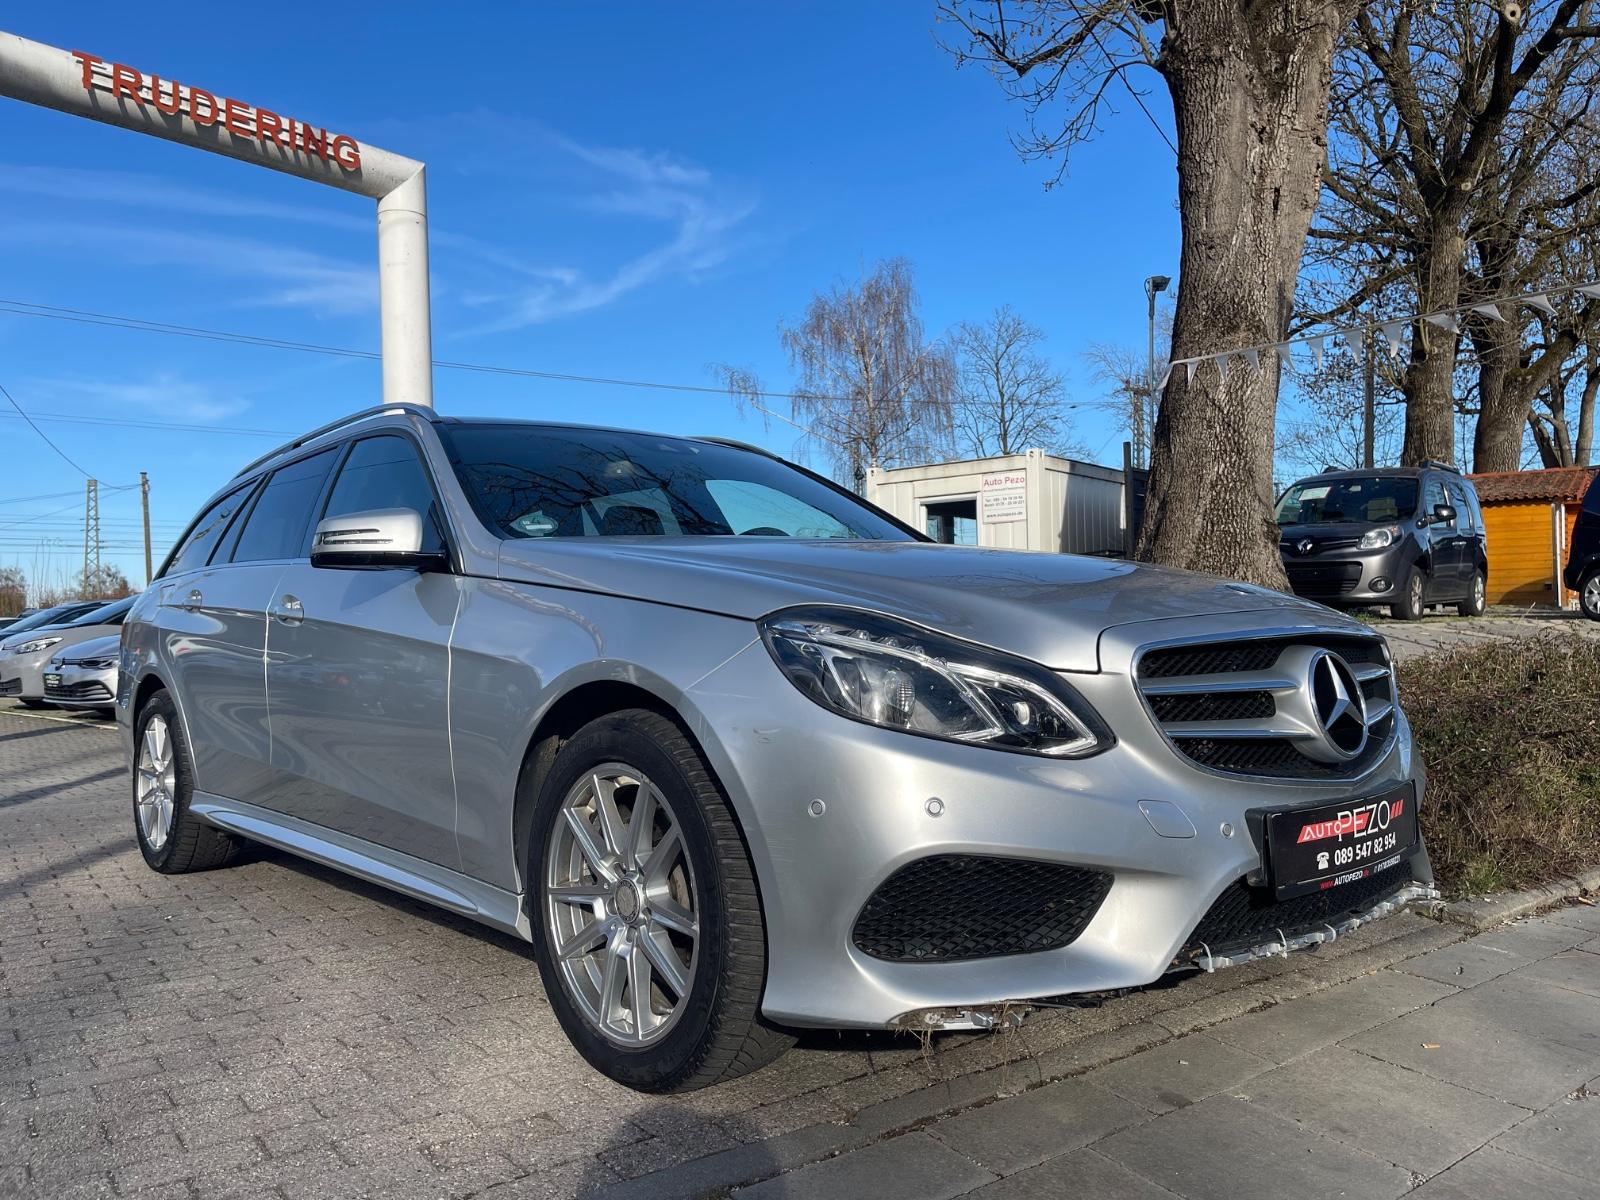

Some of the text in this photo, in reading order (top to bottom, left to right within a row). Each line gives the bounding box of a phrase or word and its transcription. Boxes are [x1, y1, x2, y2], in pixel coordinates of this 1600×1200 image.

[72, 49, 361, 169] TRUDERING
[984, 476, 1024, 487] Auto Pezo
[1334, 831, 1396, 866] 089 547 82 954
